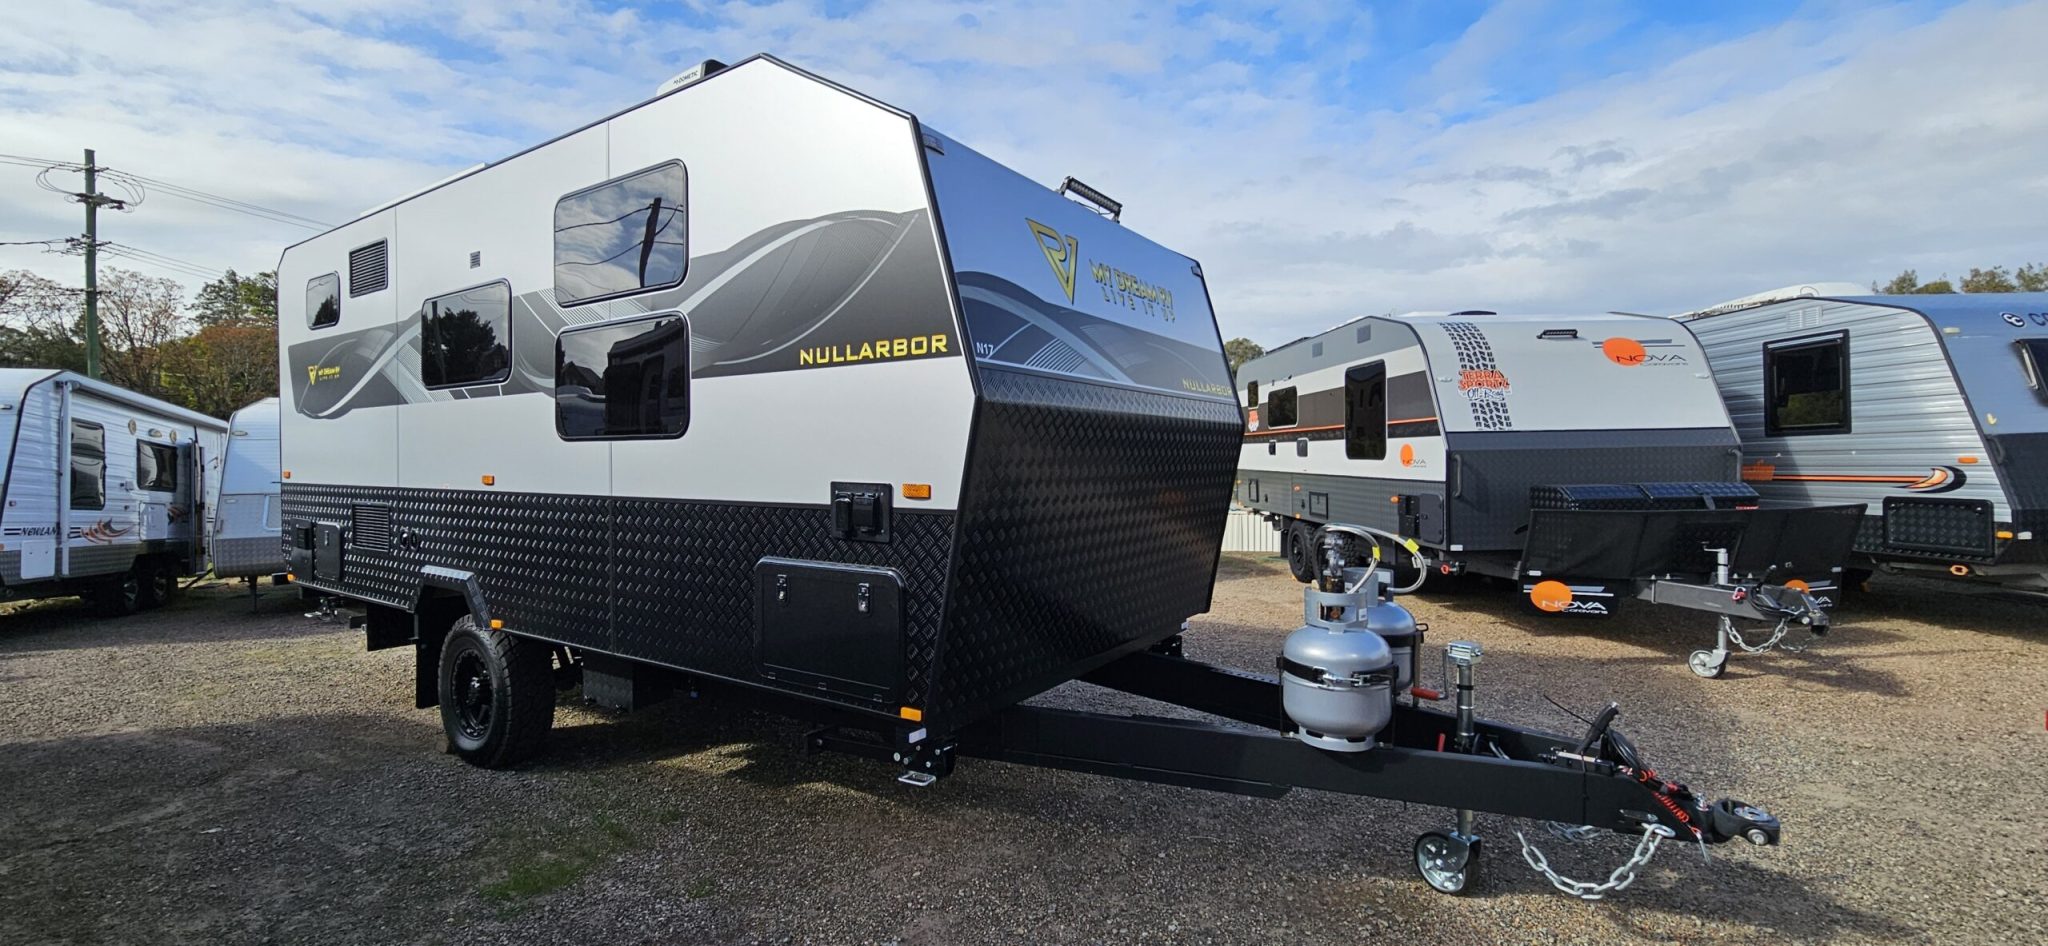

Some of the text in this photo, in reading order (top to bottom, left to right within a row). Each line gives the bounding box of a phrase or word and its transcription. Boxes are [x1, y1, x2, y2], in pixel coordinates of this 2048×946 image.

[1113, 268, 1159, 305] DREAM
[1101, 286, 1136, 311] LIVE
[799, 334, 948, 366] NULLARBOR
[976, 342, 994, 355] N17
[1615, 354, 1687, 363] NOVA
[1461, 369, 1505, 380] TERRA
[1541, 599, 1607, 611] NOVA
